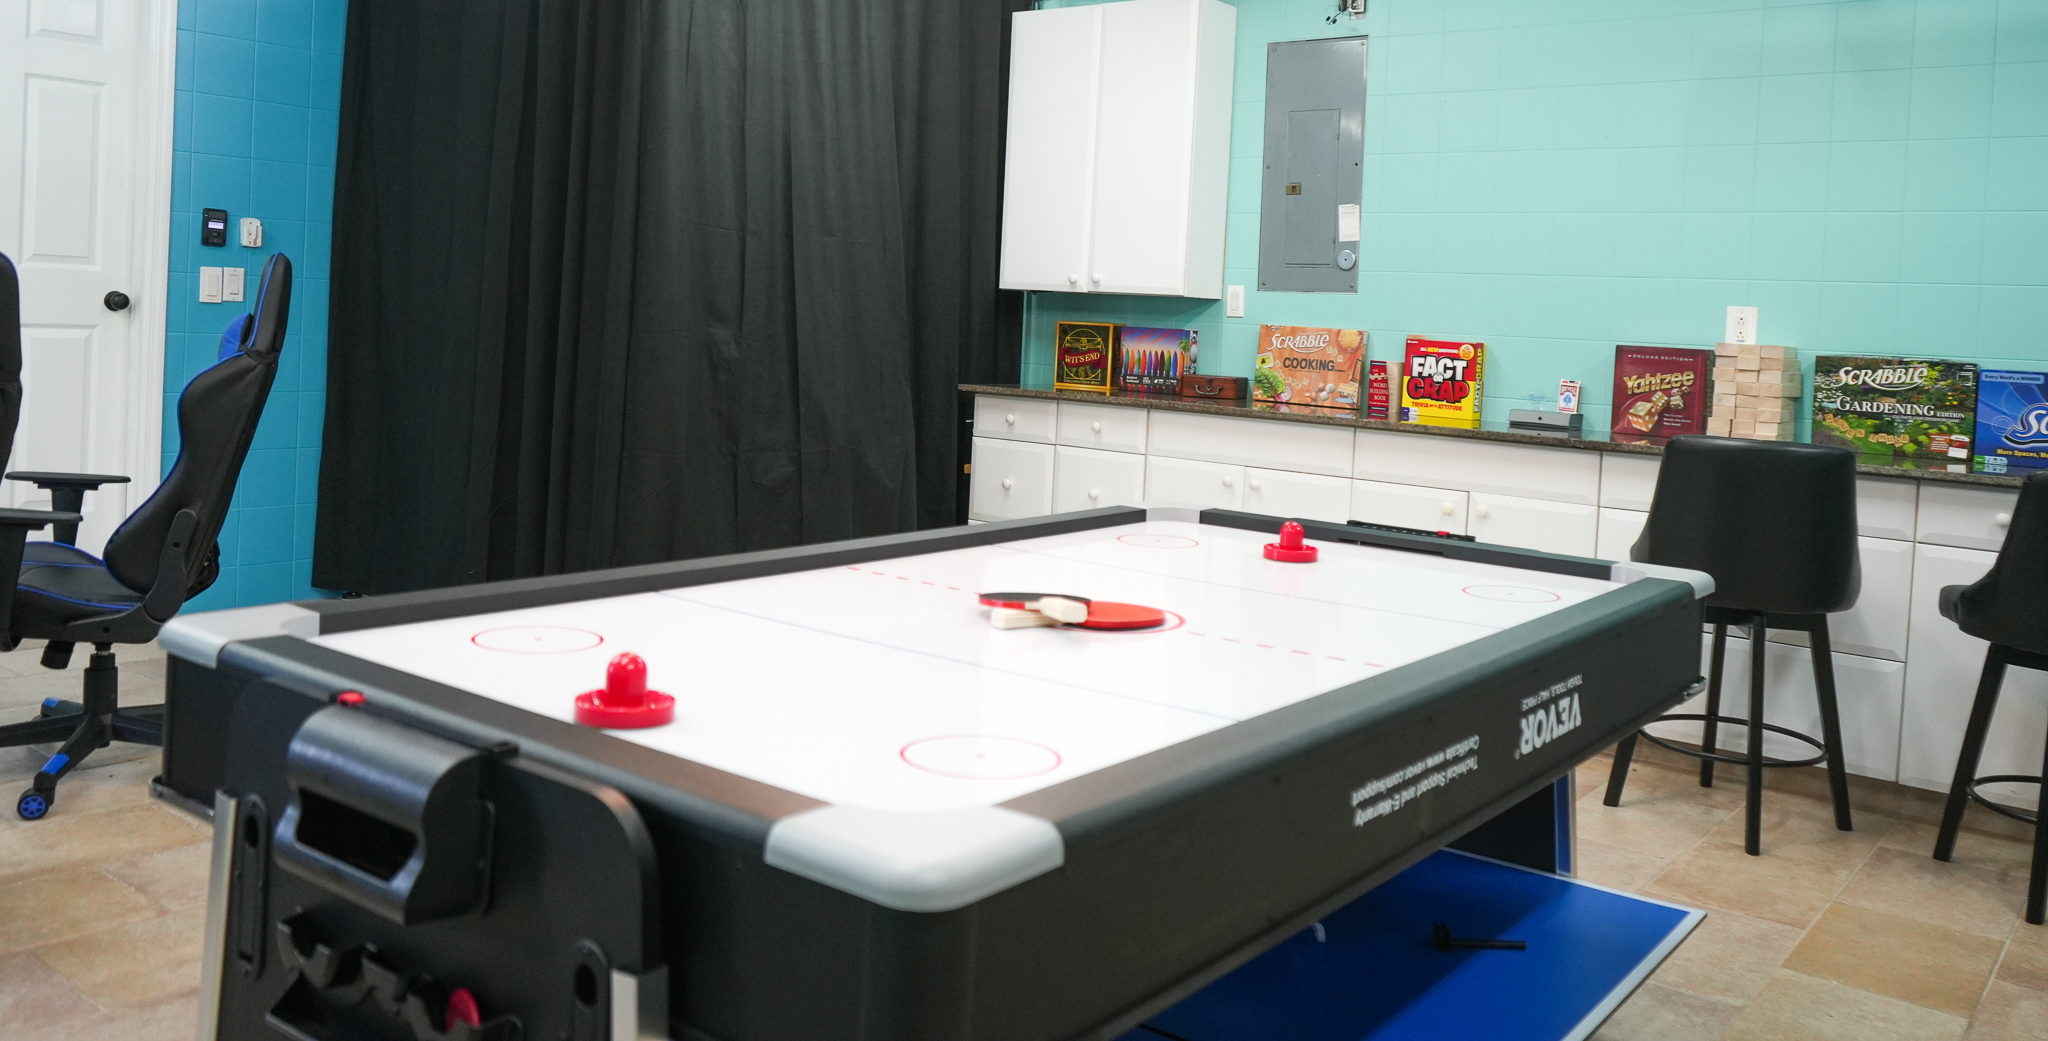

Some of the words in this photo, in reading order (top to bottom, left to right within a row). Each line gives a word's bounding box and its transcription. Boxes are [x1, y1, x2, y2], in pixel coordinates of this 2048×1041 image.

[1085, 352, 1101, 362] END
[1283, 357, 1335, 372] COOKING
[1411, 354, 1468, 381] FACT
[1407, 377, 1470, 404] CRAP
[1434, 375, 1444, 383] OR
[1623, 370, 1695, 395] Yahtzee
[1438, 403, 1463, 411] ATTITUDE
[1836, 396, 1935, 417] GARDENING
[1936, 411, 1965, 419] EDITION
[1520, 692, 1582, 756] VEVOR
[1445, 734, 1480, 761] Certificate
[1446, 755, 1478, 784] Technical
[1401, 786, 1417, 807] and
[1417, 771, 1446, 798] Support
